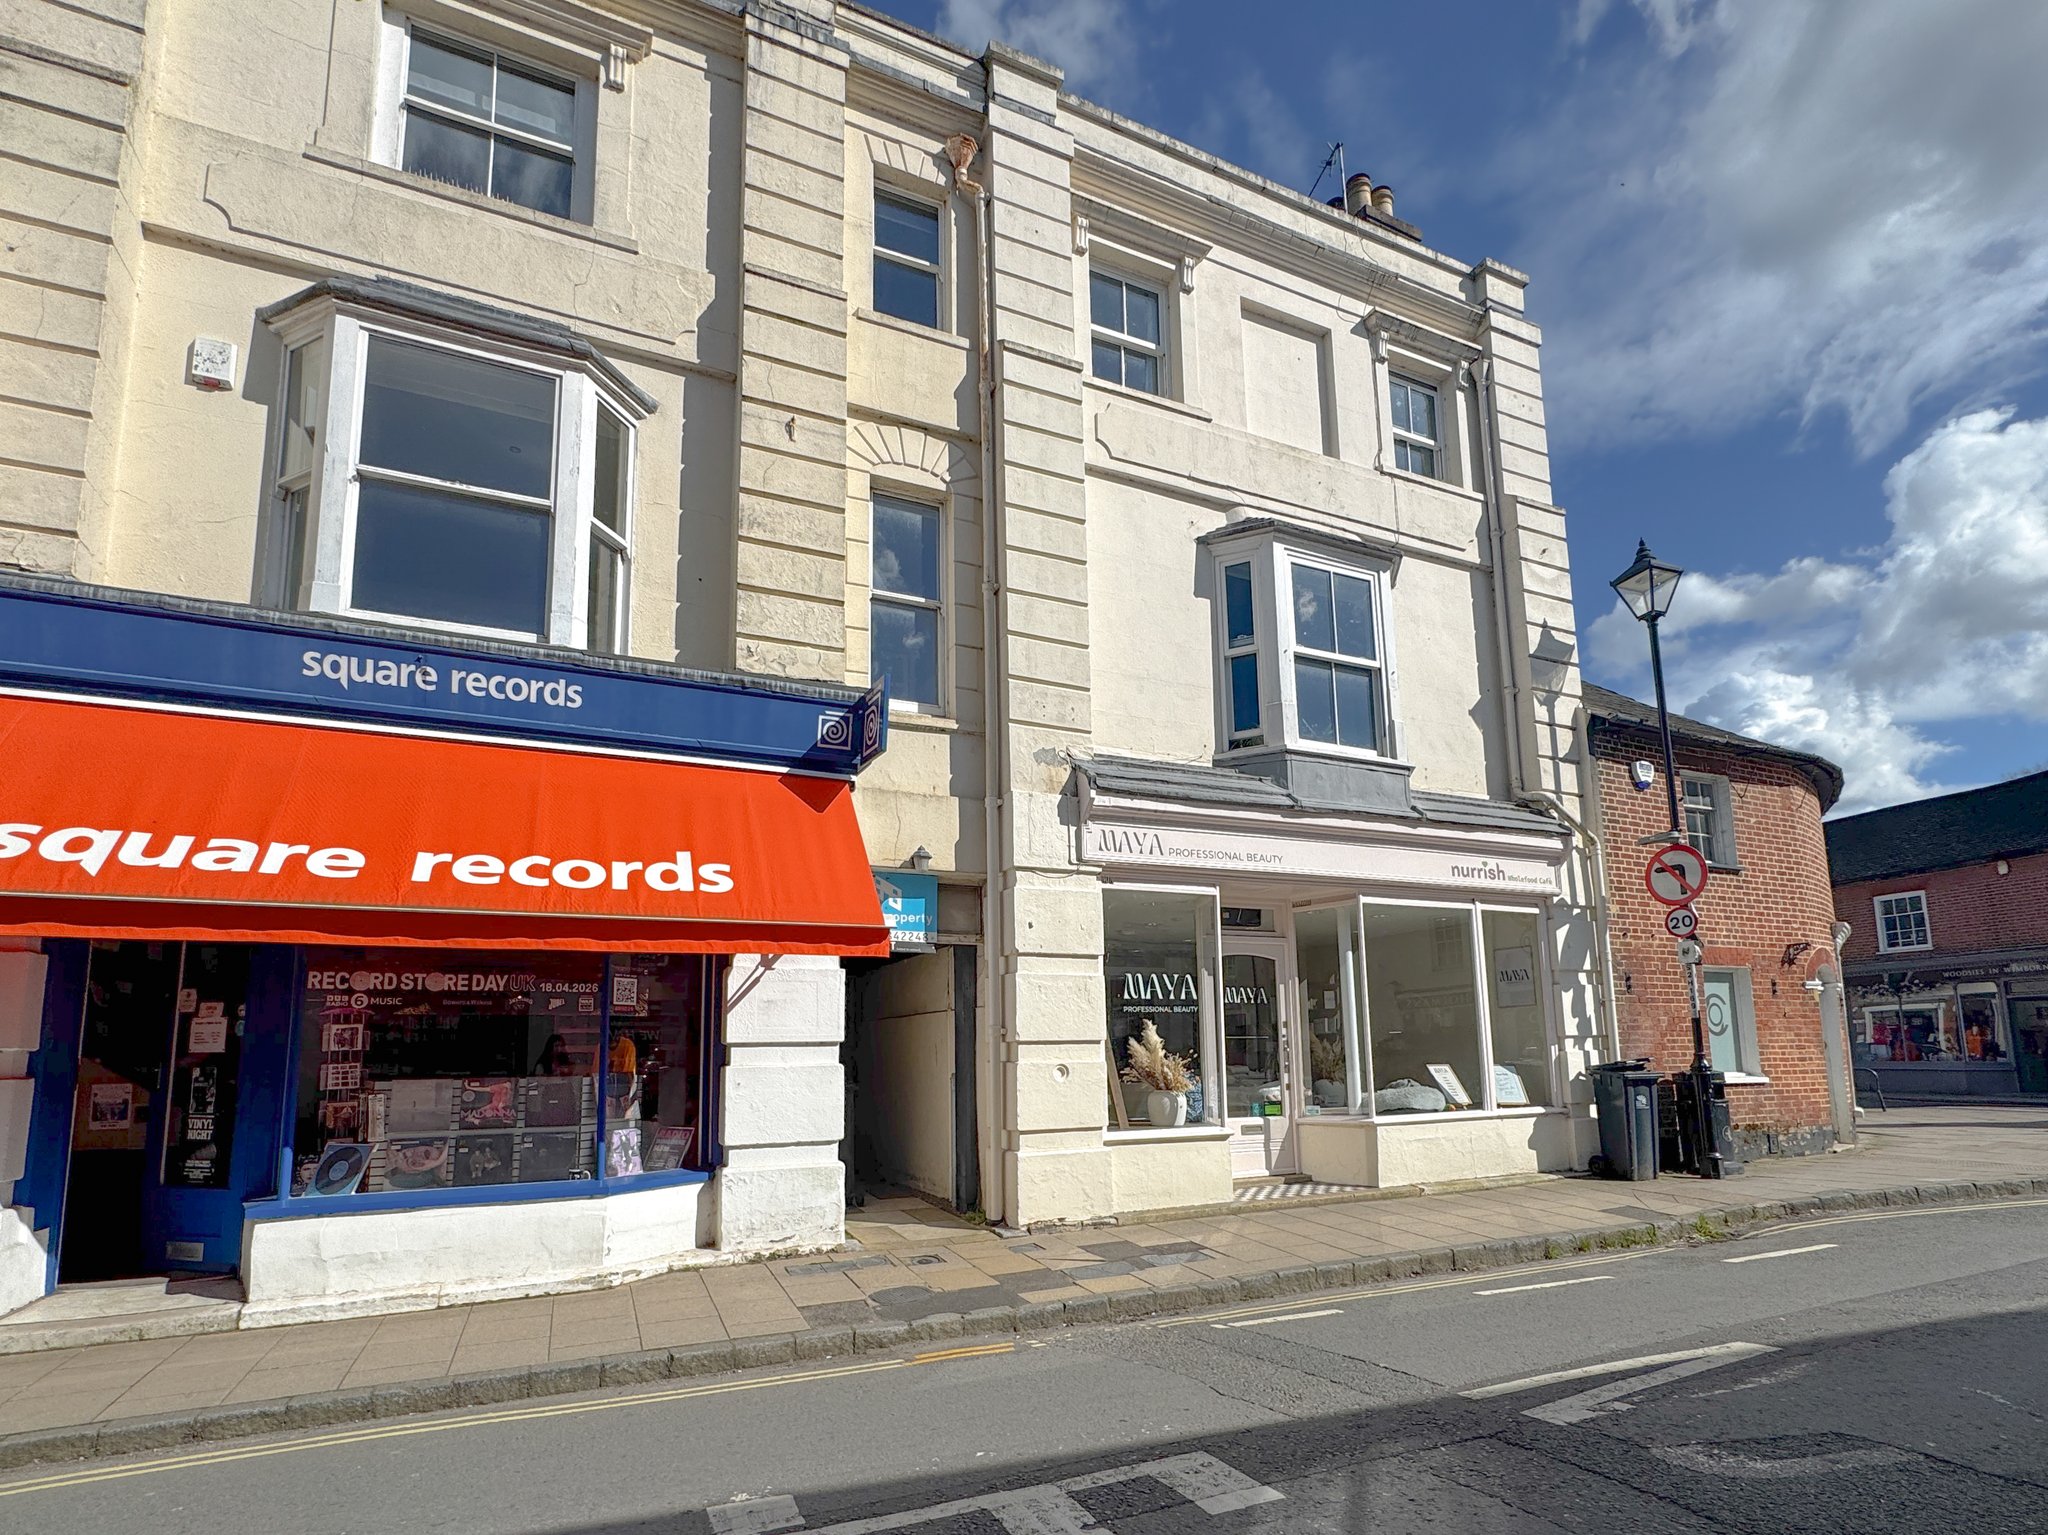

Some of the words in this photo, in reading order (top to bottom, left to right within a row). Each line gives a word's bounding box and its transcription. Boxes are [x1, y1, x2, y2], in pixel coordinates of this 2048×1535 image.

[302, 651, 438, 690] square
[451, 668, 583, 709] records
[1099, 829, 1164, 856] MAYA
[1168, 848, 1244, 861] PROFESSIONAL
[1247, 853, 1284, 864] BEAUTY
[0, 821, 365, 877] square
[411, 850, 734, 893] records
[1451, 861, 1506, 881] nurrish
[885, 912, 932, 925] operty
[1670, 914, 1693, 930] 20
[1942, 968, 1985, 977] WOODSIES
[307, 971, 398, 991] RECORD
[400, 972, 469, 991] STORE
[471, 974, 509, 991] DAY
[510, 974, 536, 992] UK
[539, 983, 599, 993] 18.04.2026
[1123, 973, 1198, 1000] MAYA
[370, 997, 403, 1005] MUSIC
[1224, 987, 1268, 1004] MAYA
[1123, 1006, 1172, 1014] PROFESSIONAL
[461, 1108, 517, 1119] MADONNA
[188, 1119, 214, 1129] VINYL
[187, 1129, 213, 1140] NIGHT
